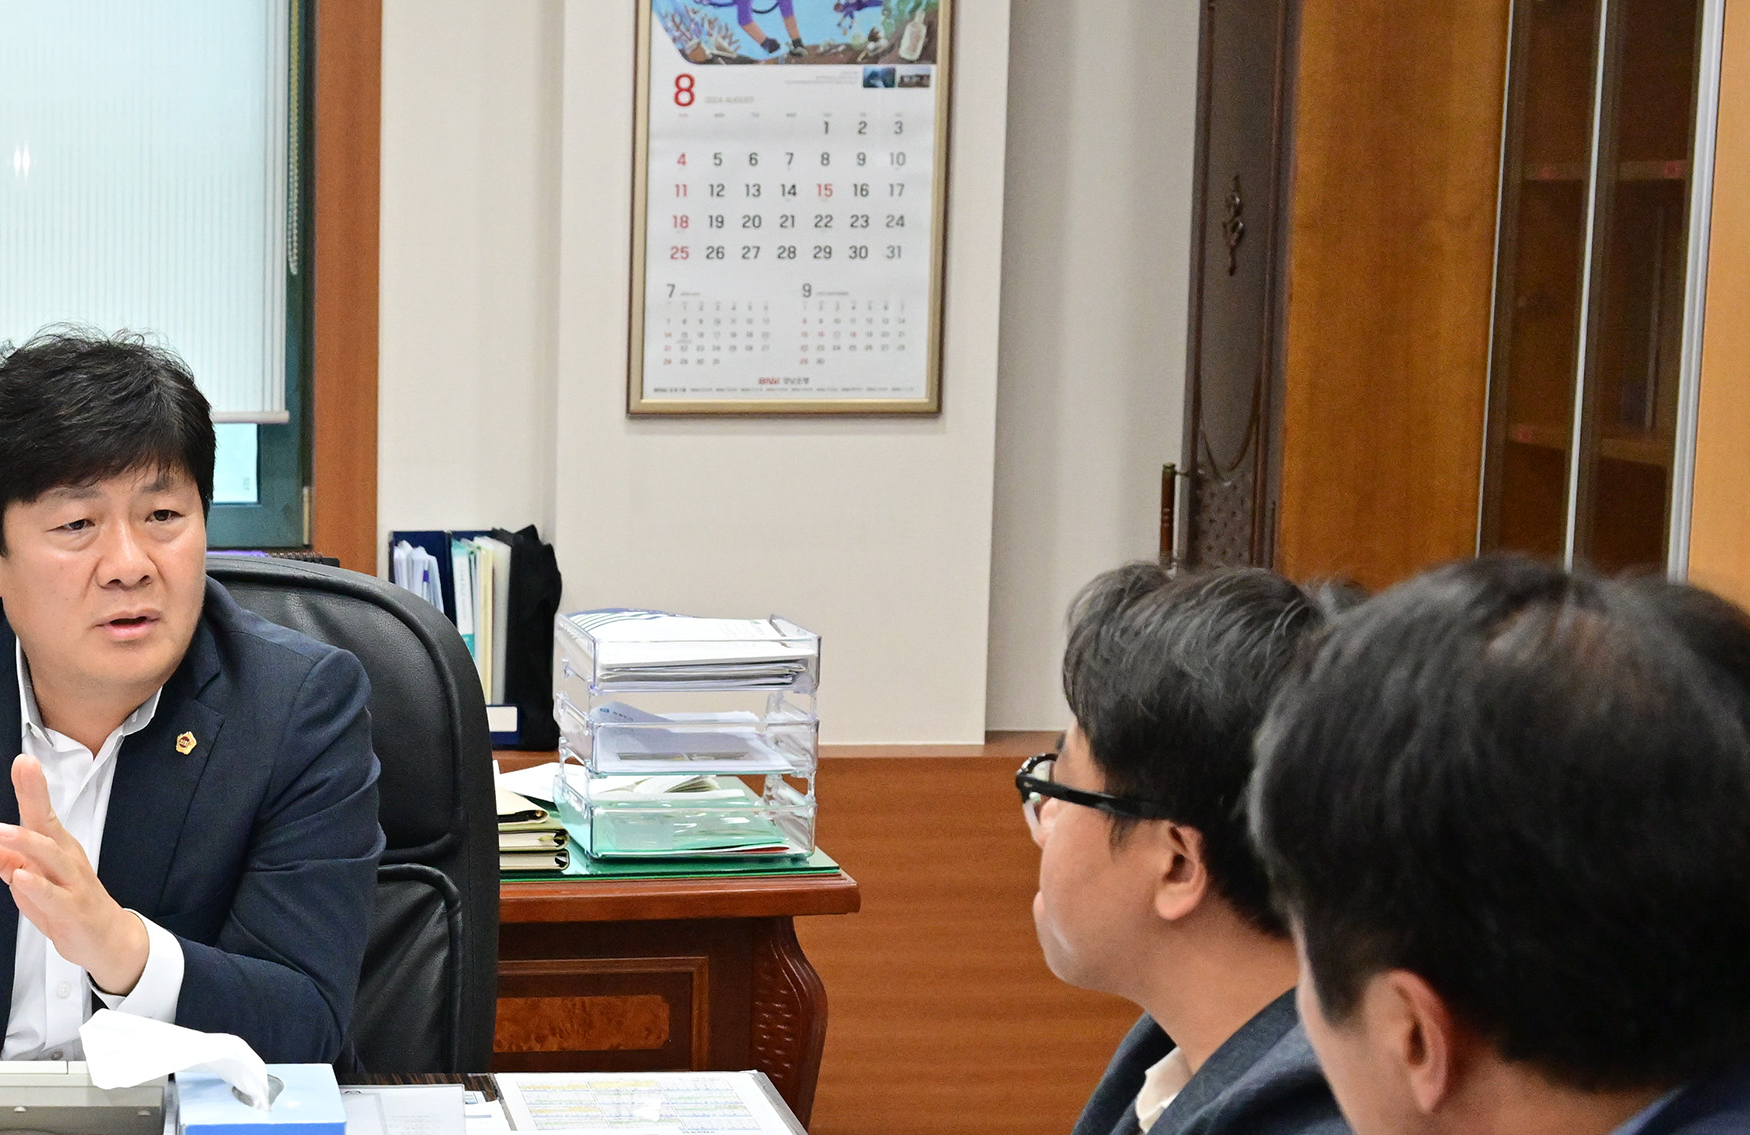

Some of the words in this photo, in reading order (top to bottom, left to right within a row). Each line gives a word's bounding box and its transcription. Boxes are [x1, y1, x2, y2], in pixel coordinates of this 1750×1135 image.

[673, 73, 696, 108] 8
[823, 121, 830, 134] 1
[857, 121, 867, 135] 2
[894, 121, 903, 135] 3
[676, 153, 686, 166] 4
[713, 153, 722, 166] 5
[748, 152, 758, 166] 6
[785, 152, 794, 165] 7
[820, 152, 830, 166] 8
[856, 152, 866, 166] 9
[889, 152, 906, 166] 10
[675, 184, 687, 197] 11
[709, 184, 725, 197] 12
[745, 184, 761, 197] 13
[780, 184, 796, 196] 14
[817, 184, 833, 197] 15
[853, 183, 869, 197] 16
[889, 183, 905, 197] 17
[672, 215, 689, 229] 18
[708, 215, 724, 228] 19
[741, 215, 761, 228] 20
[779, 215, 794, 228] 21
[814, 215, 833, 228] 22
[849, 214, 869, 228] 23
[885, 215, 905, 228] 24
[670, 246, 689, 260] 25
[705, 246, 724, 259] 26
[741, 246, 760, 259] 27
[777, 246, 796, 259] 28
[812, 246, 832, 259] 29
[848, 246, 868, 259] 30
[885, 245, 901, 259] 31
[666, 283, 676, 298] 7
[802, 283, 812, 298] 9
